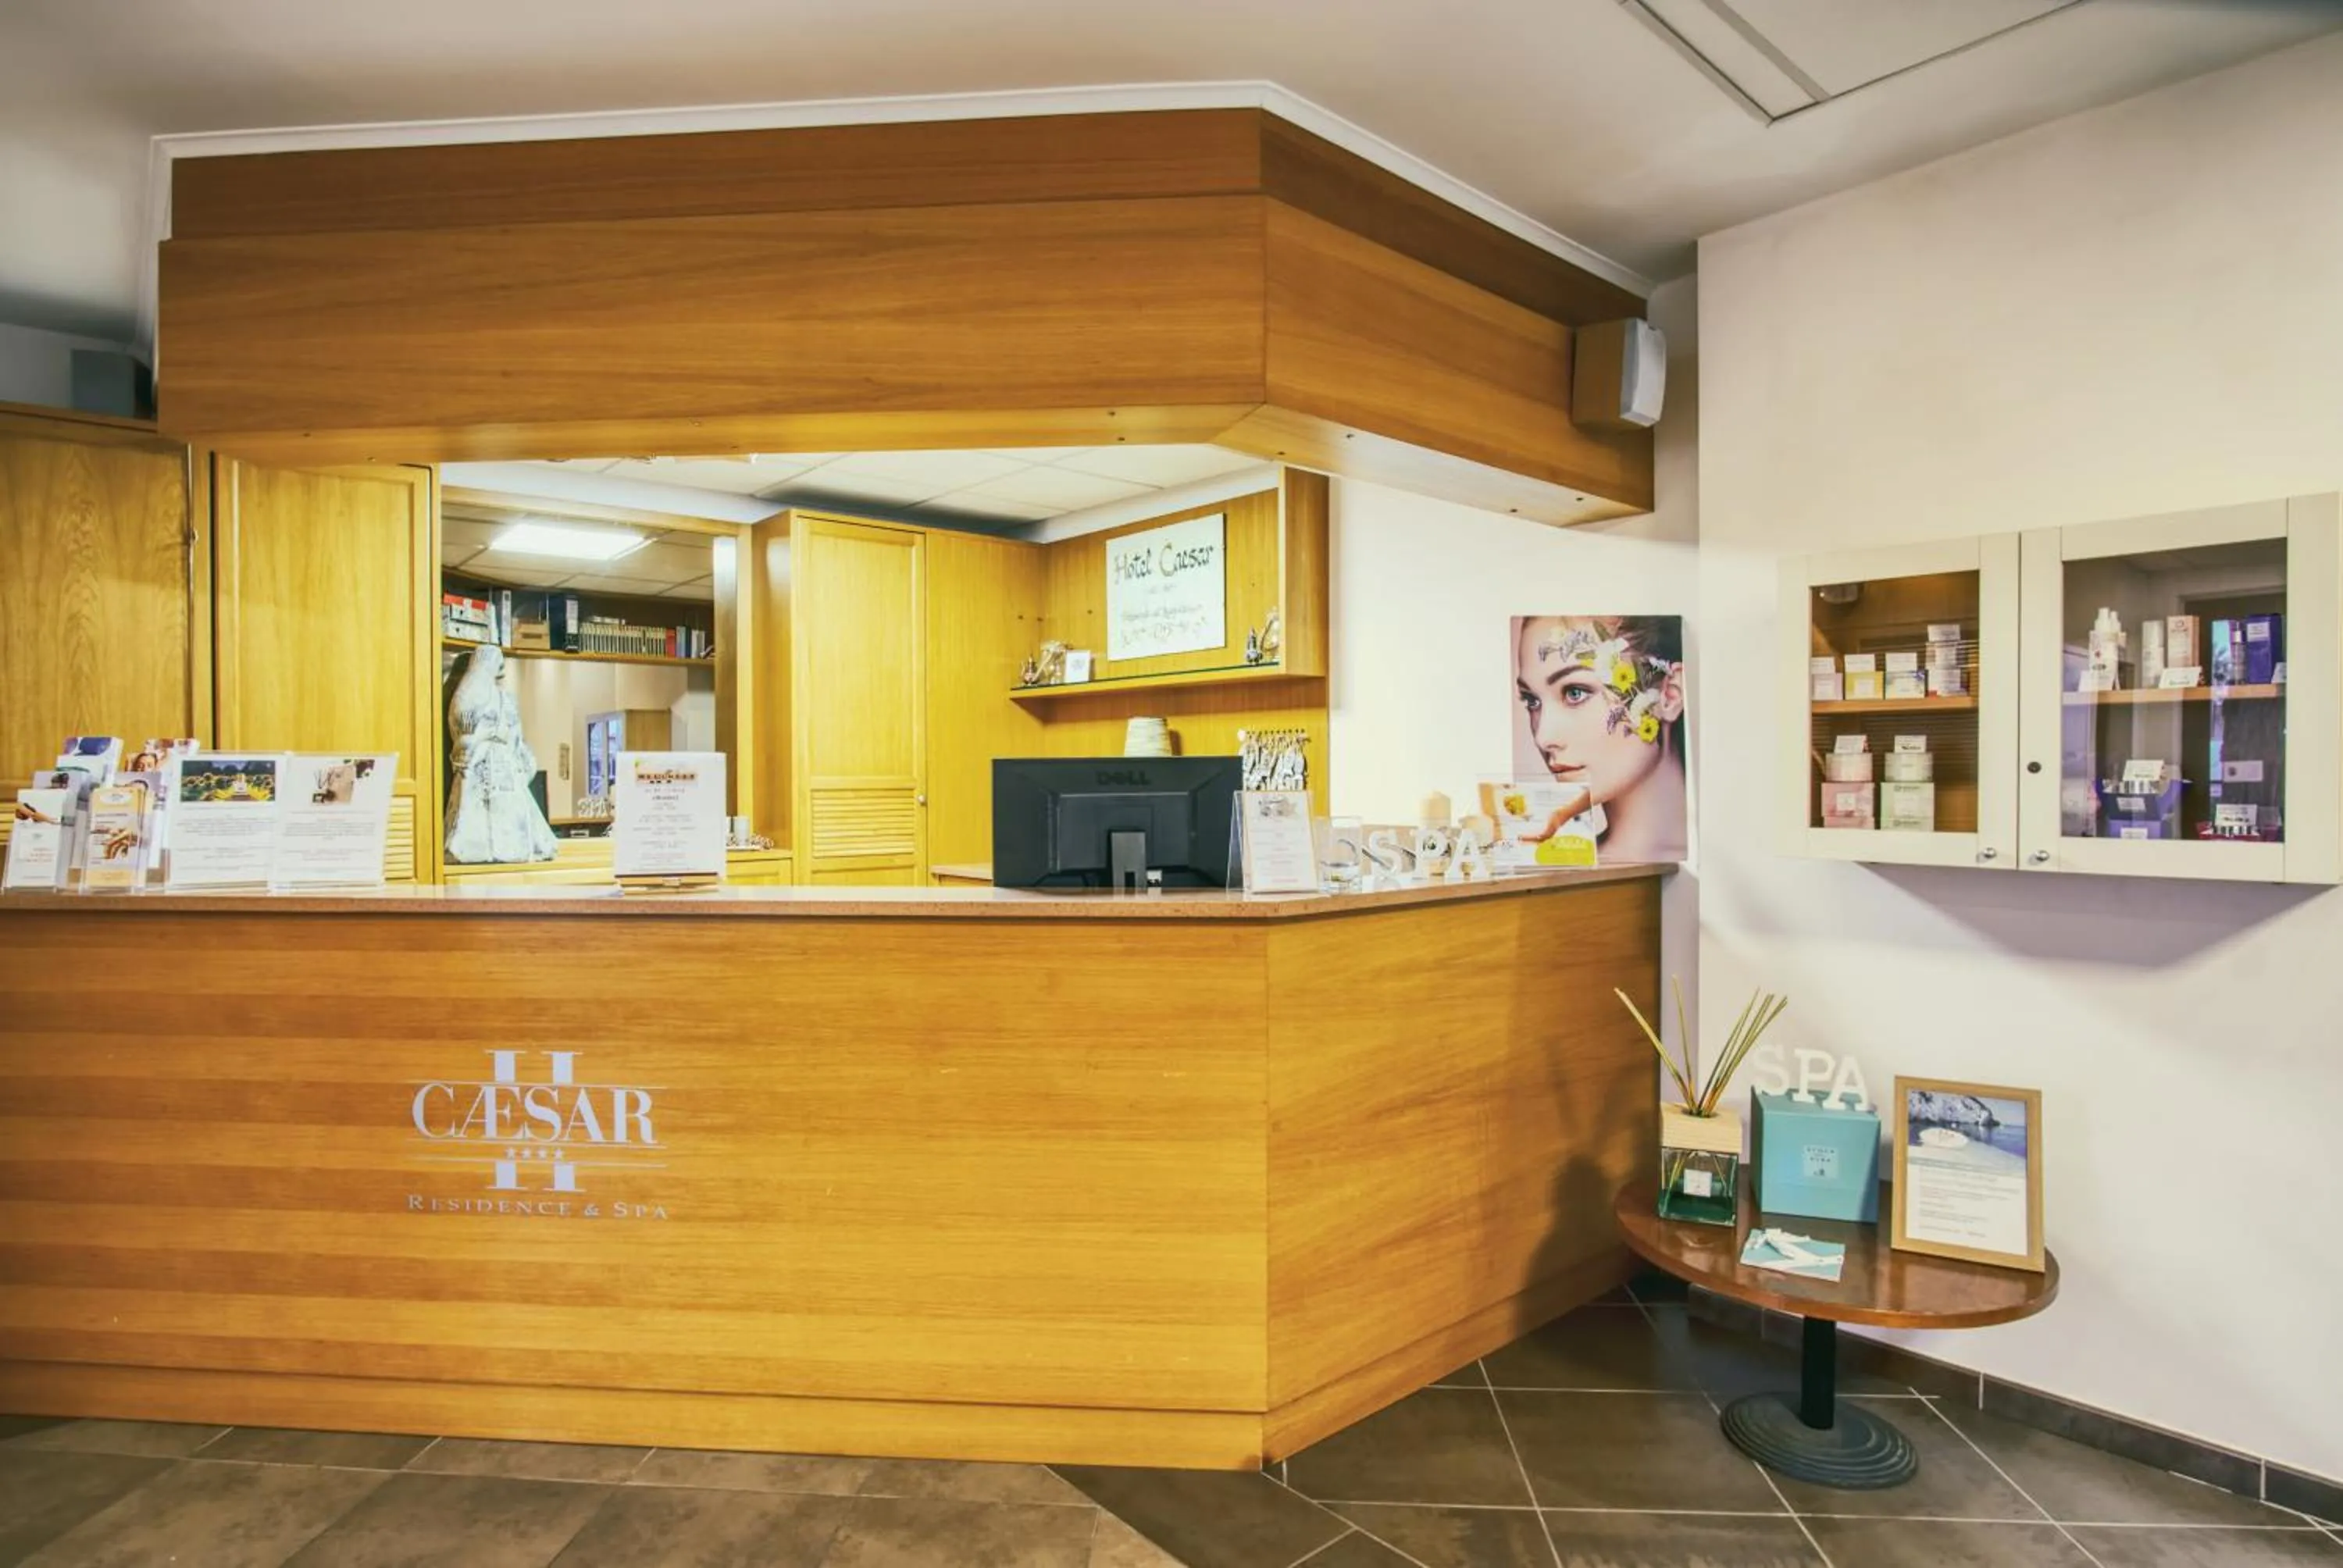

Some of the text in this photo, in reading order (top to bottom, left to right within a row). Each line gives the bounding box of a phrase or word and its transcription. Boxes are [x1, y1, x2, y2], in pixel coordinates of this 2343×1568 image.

[1114, 542, 1214, 585] Hotel Caesar
[1097, 770, 1151, 786] DELL
[1368, 827, 1490, 880] SPA
[1752, 1044, 1869, 1112] SPA
[583, 1203, 601, 1217] &
